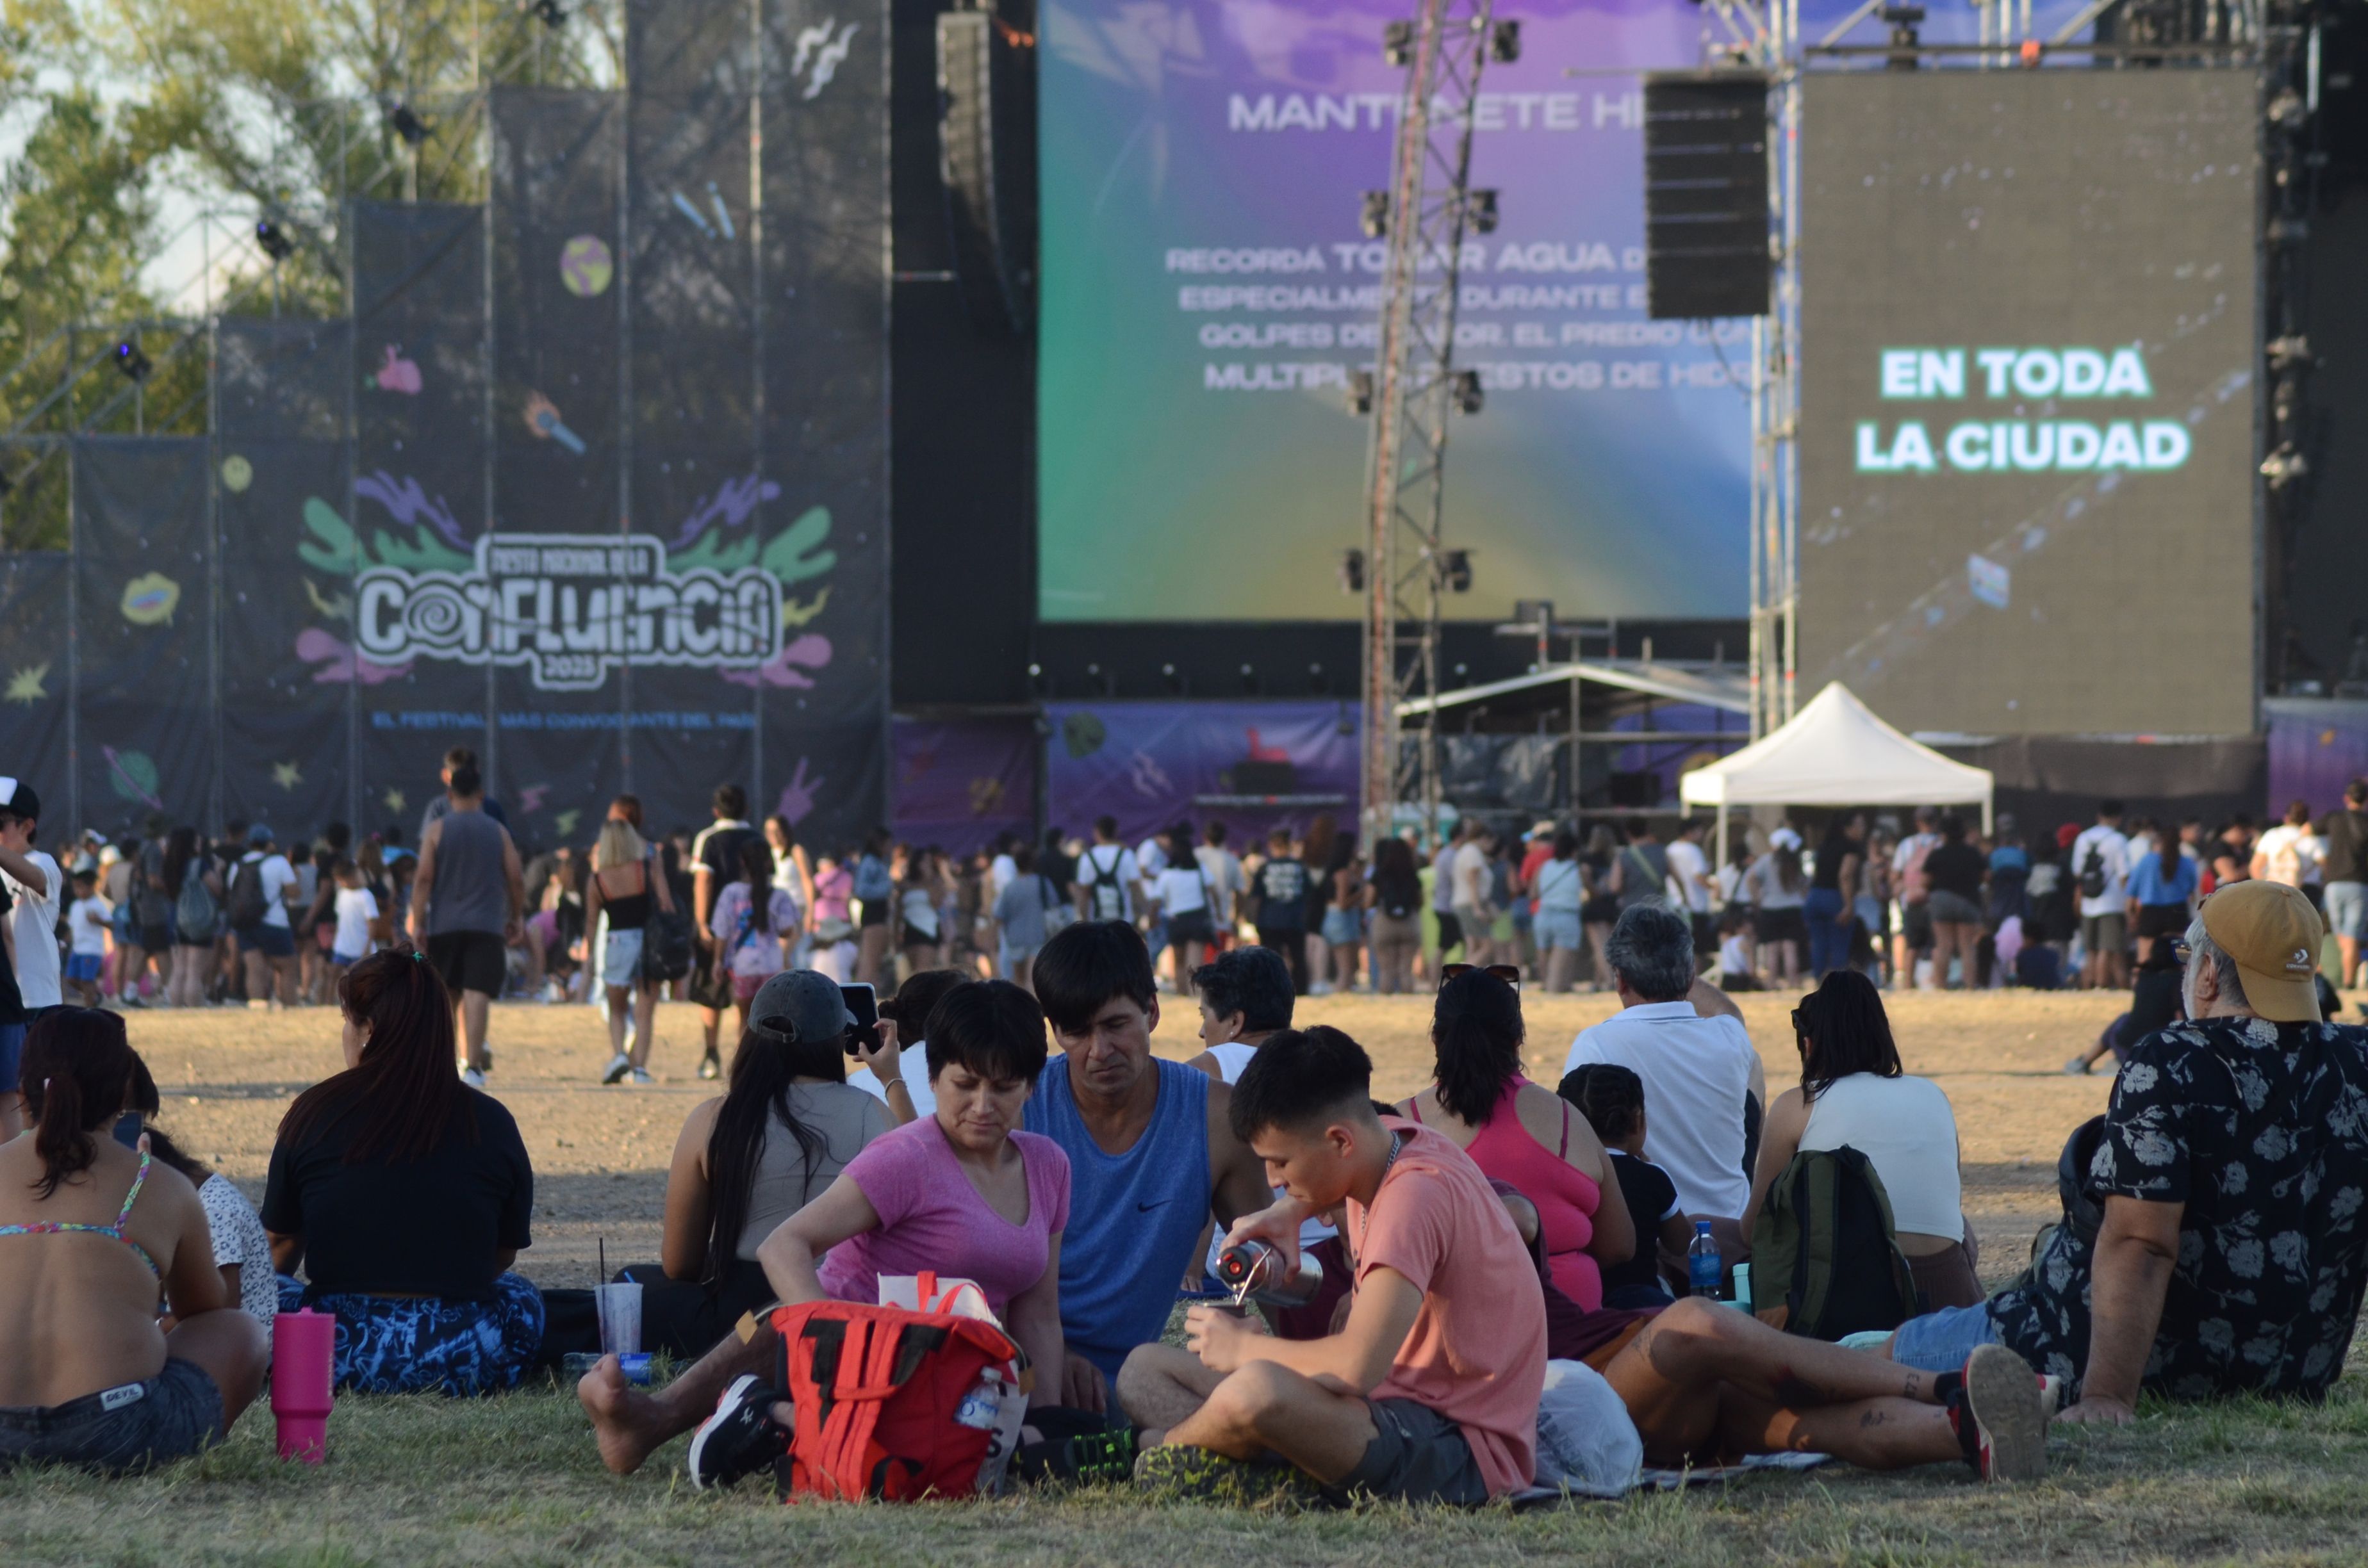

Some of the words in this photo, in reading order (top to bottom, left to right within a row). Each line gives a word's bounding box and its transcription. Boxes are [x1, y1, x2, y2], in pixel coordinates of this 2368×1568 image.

[1495, 242, 1617, 272] AGUA
[1461, 284, 1620, 310] DURANTE
[1199, 323, 1335, 348] GOLPES
[1513, 322, 1556, 347] EL
[1561, 322, 1682, 347] PREDIO
[1611, 362, 1663, 389] DE
[1881, 348, 1965, 398] EN
[1976, 348, 2153, 398] TODA
[1857, 422, 1937, 470] LA
[1945, 422, 2191, 470] CIUDAD
